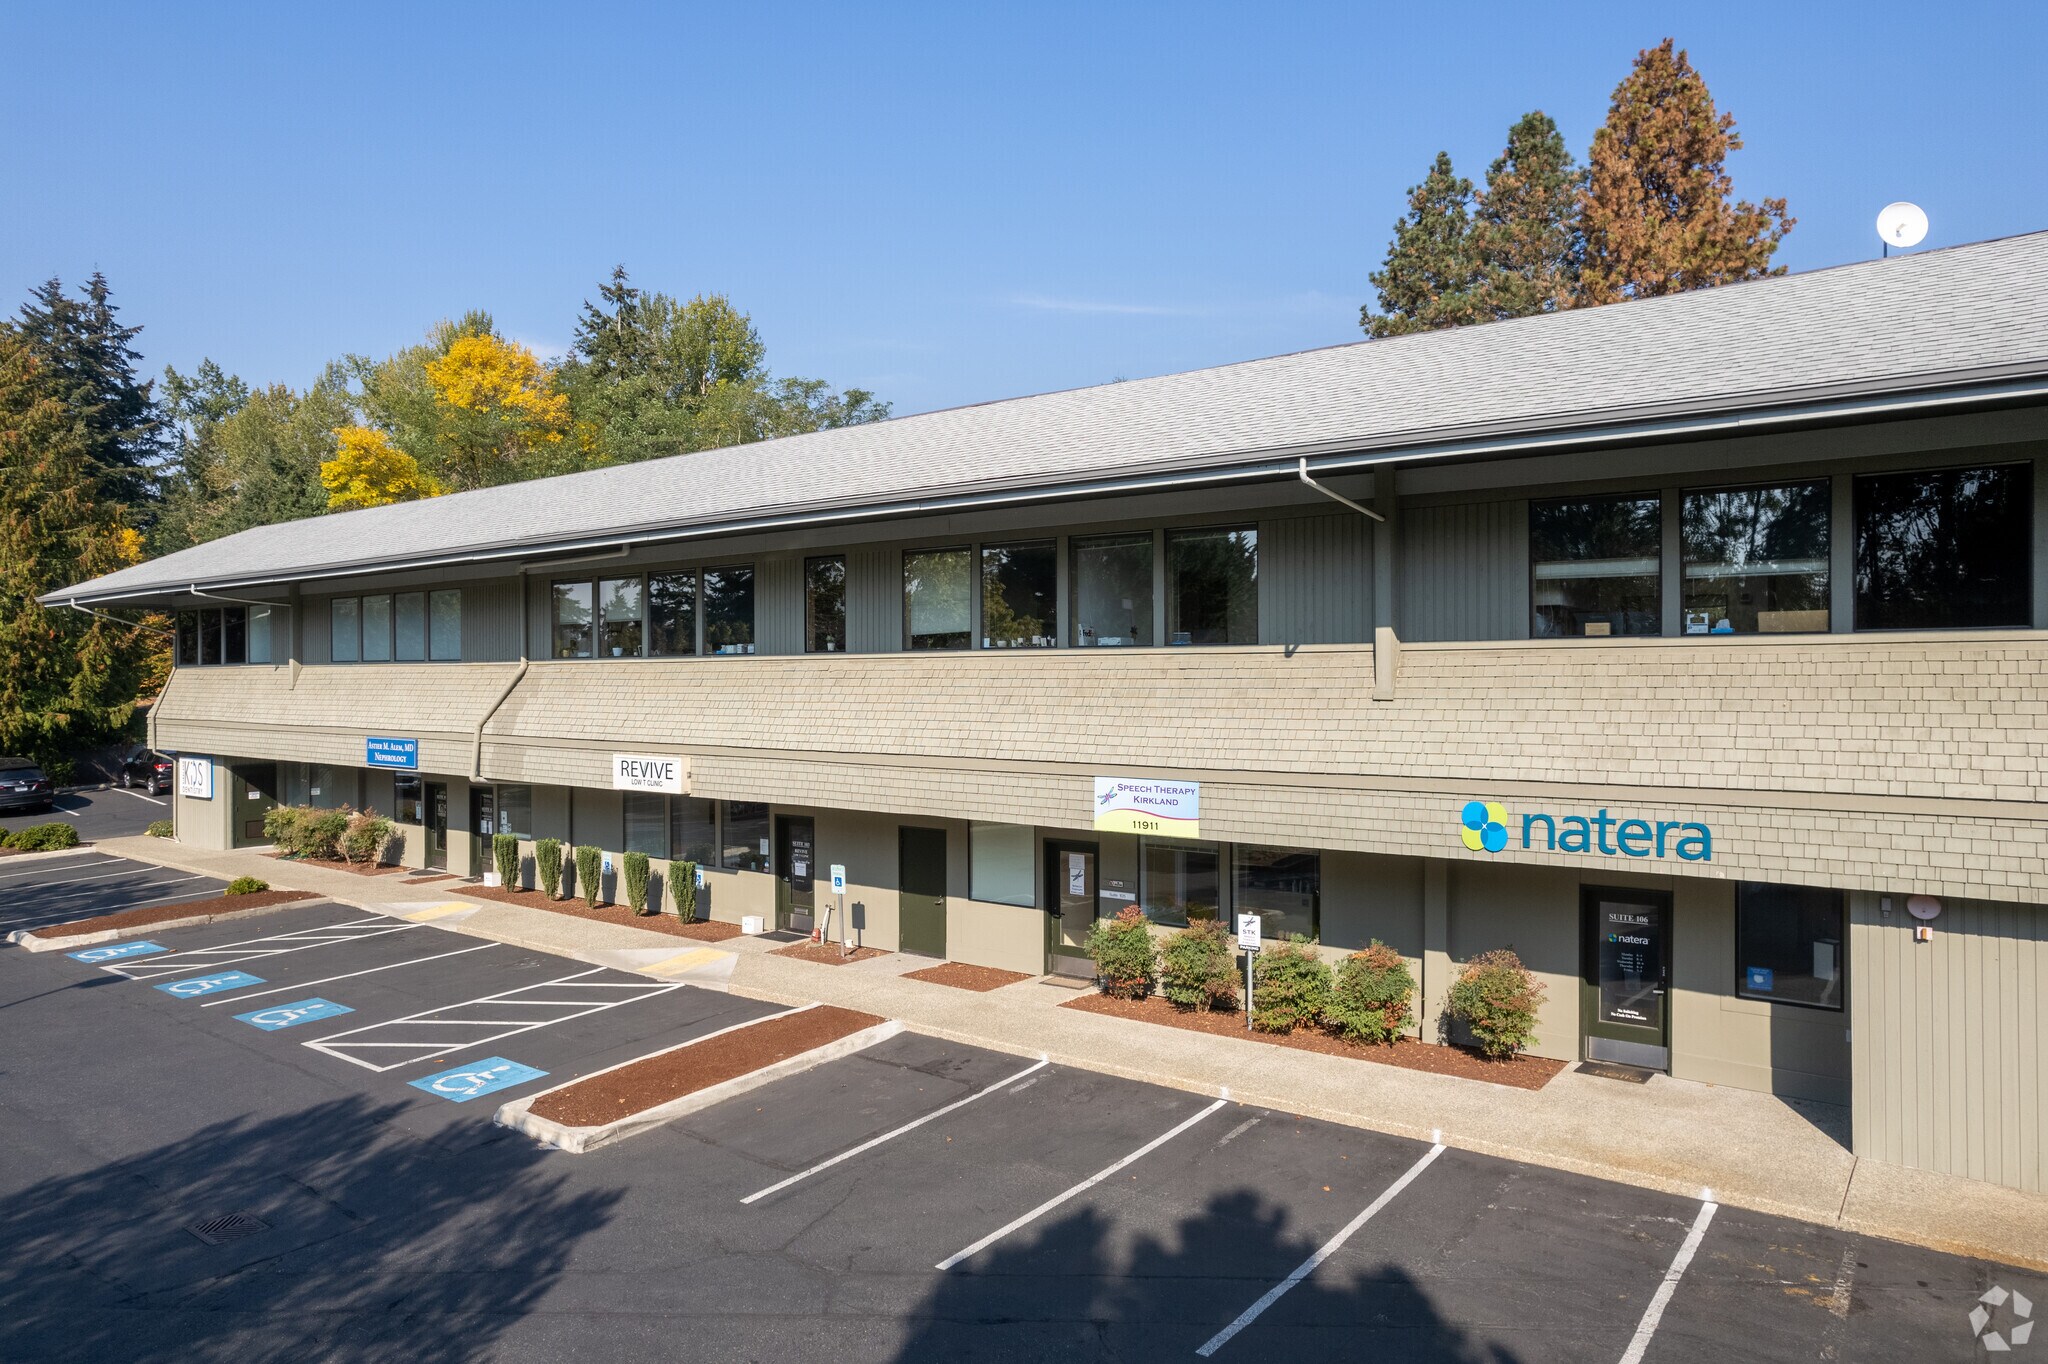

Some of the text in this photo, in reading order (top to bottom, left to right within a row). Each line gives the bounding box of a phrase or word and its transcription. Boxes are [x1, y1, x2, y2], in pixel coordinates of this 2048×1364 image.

[405, 743, 414, 752] MD
[374, 752, 407, 763] NEPHROLOGY
[621, 760, 674, 780] REVIVE
[1117, 783, 1196, 796] SPEECH THERAPY
[1133, 795, 1179, 806] KIRKLAND
[1132, 820, 1159, 831] 11911
[1522, 808, 1712, 862] natera
[1608, 913, 1649, 923] SUITE 106
[1618, 935, 1649, 945] natera
